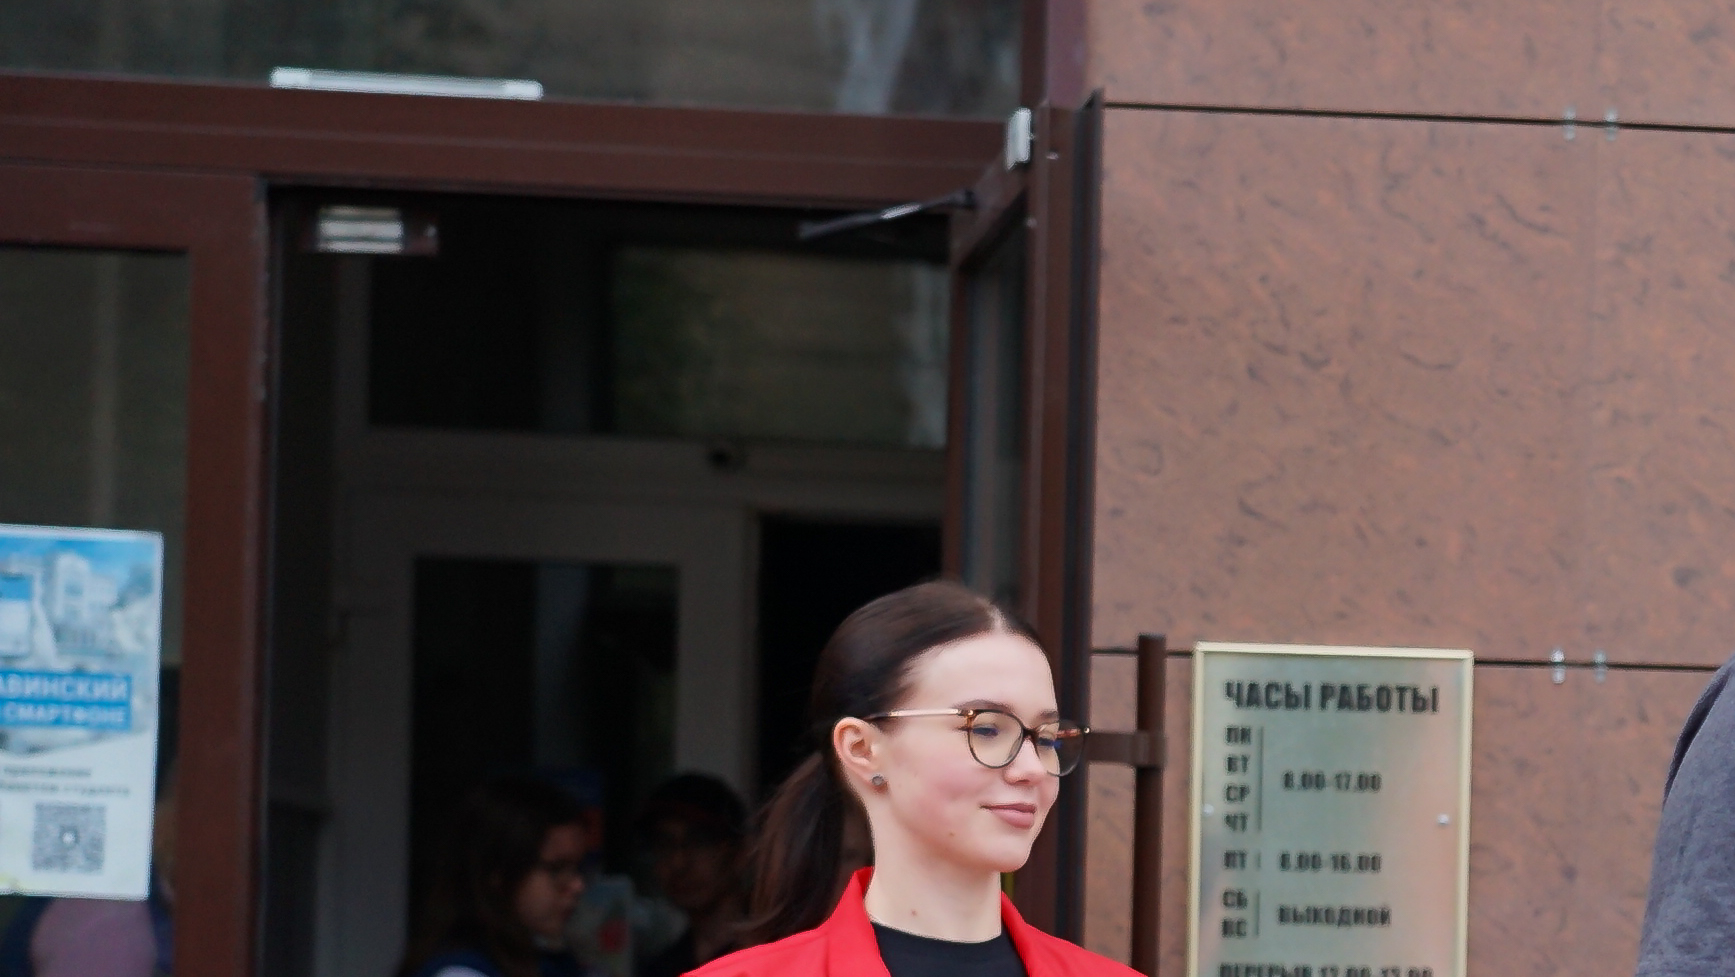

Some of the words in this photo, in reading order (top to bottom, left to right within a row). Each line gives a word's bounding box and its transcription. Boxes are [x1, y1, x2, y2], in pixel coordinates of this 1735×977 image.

[0, 674, 128, 699] ВИНСКИЙ
[1225, 681, 1311, 710] ЧАСЫ
[1319, 683, 1439, 713] РАБОТЫ
[1226, 726, 1251, 744] ПН
[1226, 756, 1249, 773] ВТ
[1226, 785, 1249, 802] СР
[1225, 814, 1248, 832] ЧТ
[1224, 851, 1247, 870] ПТ
[1223, 891, 1248, 908] СБ
[1279, 905, 1390, 927] ВЫХОДНОЙ
[1222, 919, 1246, 937] ВС
